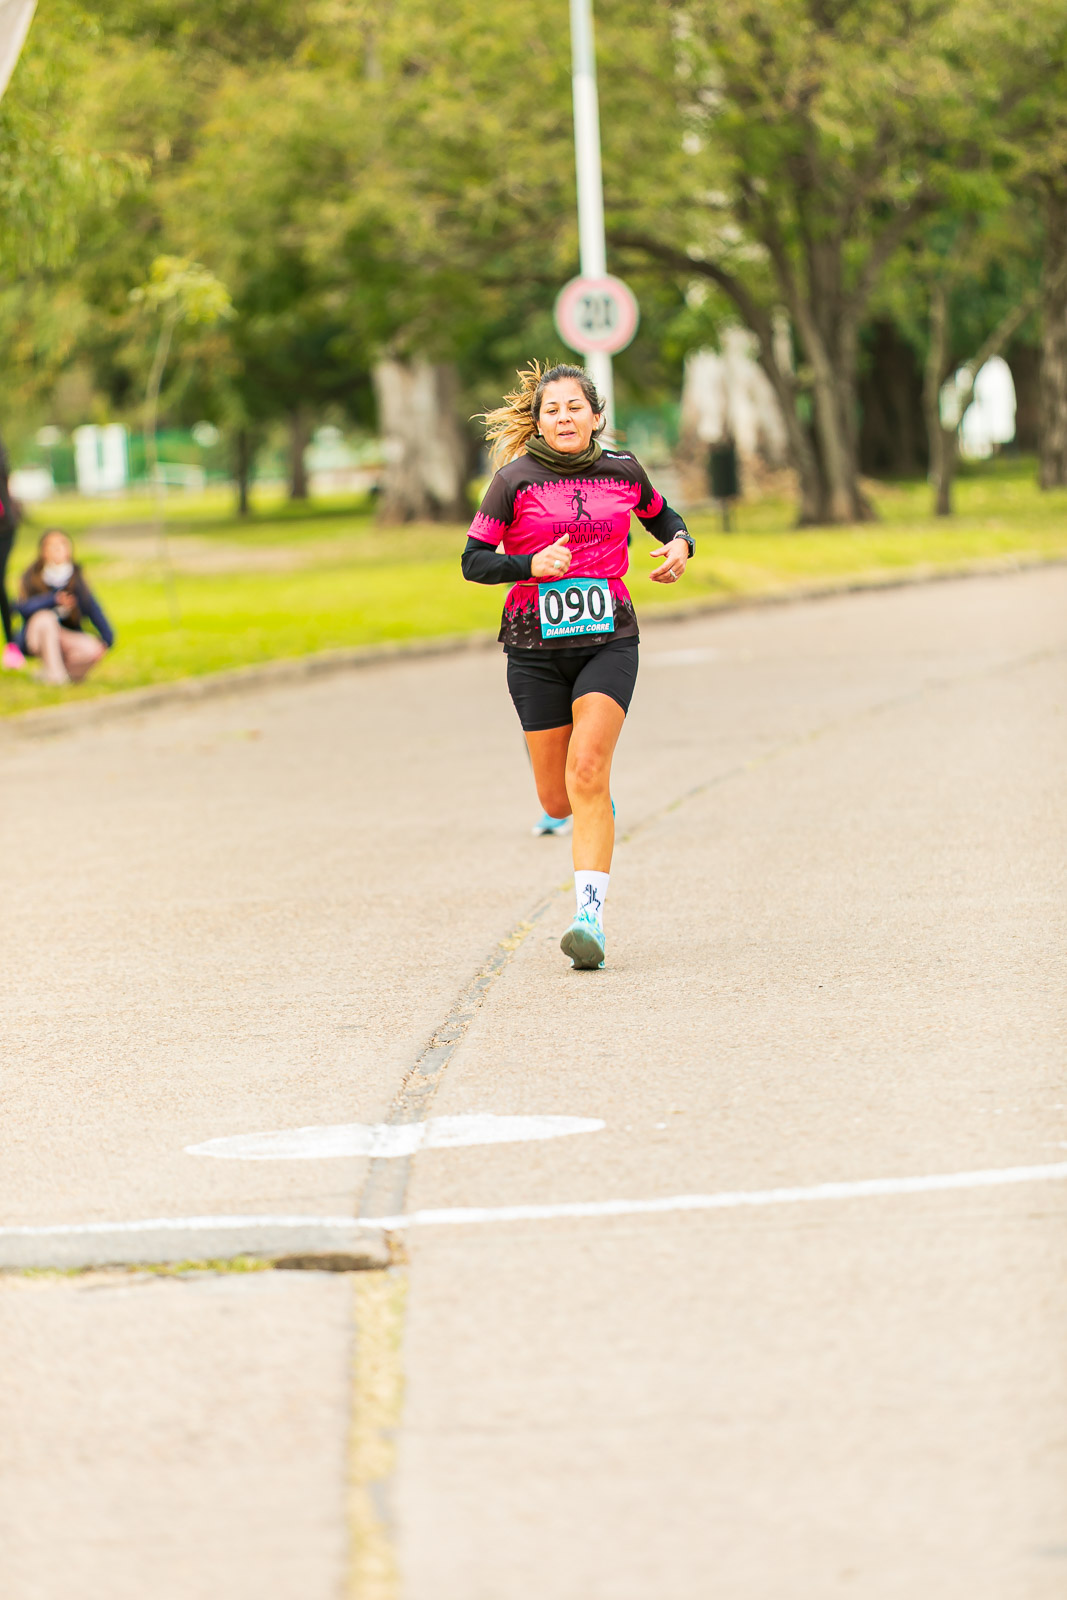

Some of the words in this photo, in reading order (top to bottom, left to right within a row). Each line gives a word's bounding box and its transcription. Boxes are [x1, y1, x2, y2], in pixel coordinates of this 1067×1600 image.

[552, 521, 613, 535] WOMAN
[544, 585, 606, 625] 090
[546, 625, 585, 636] DIAMANTE
[586, 623, 610, 632] CORRE
